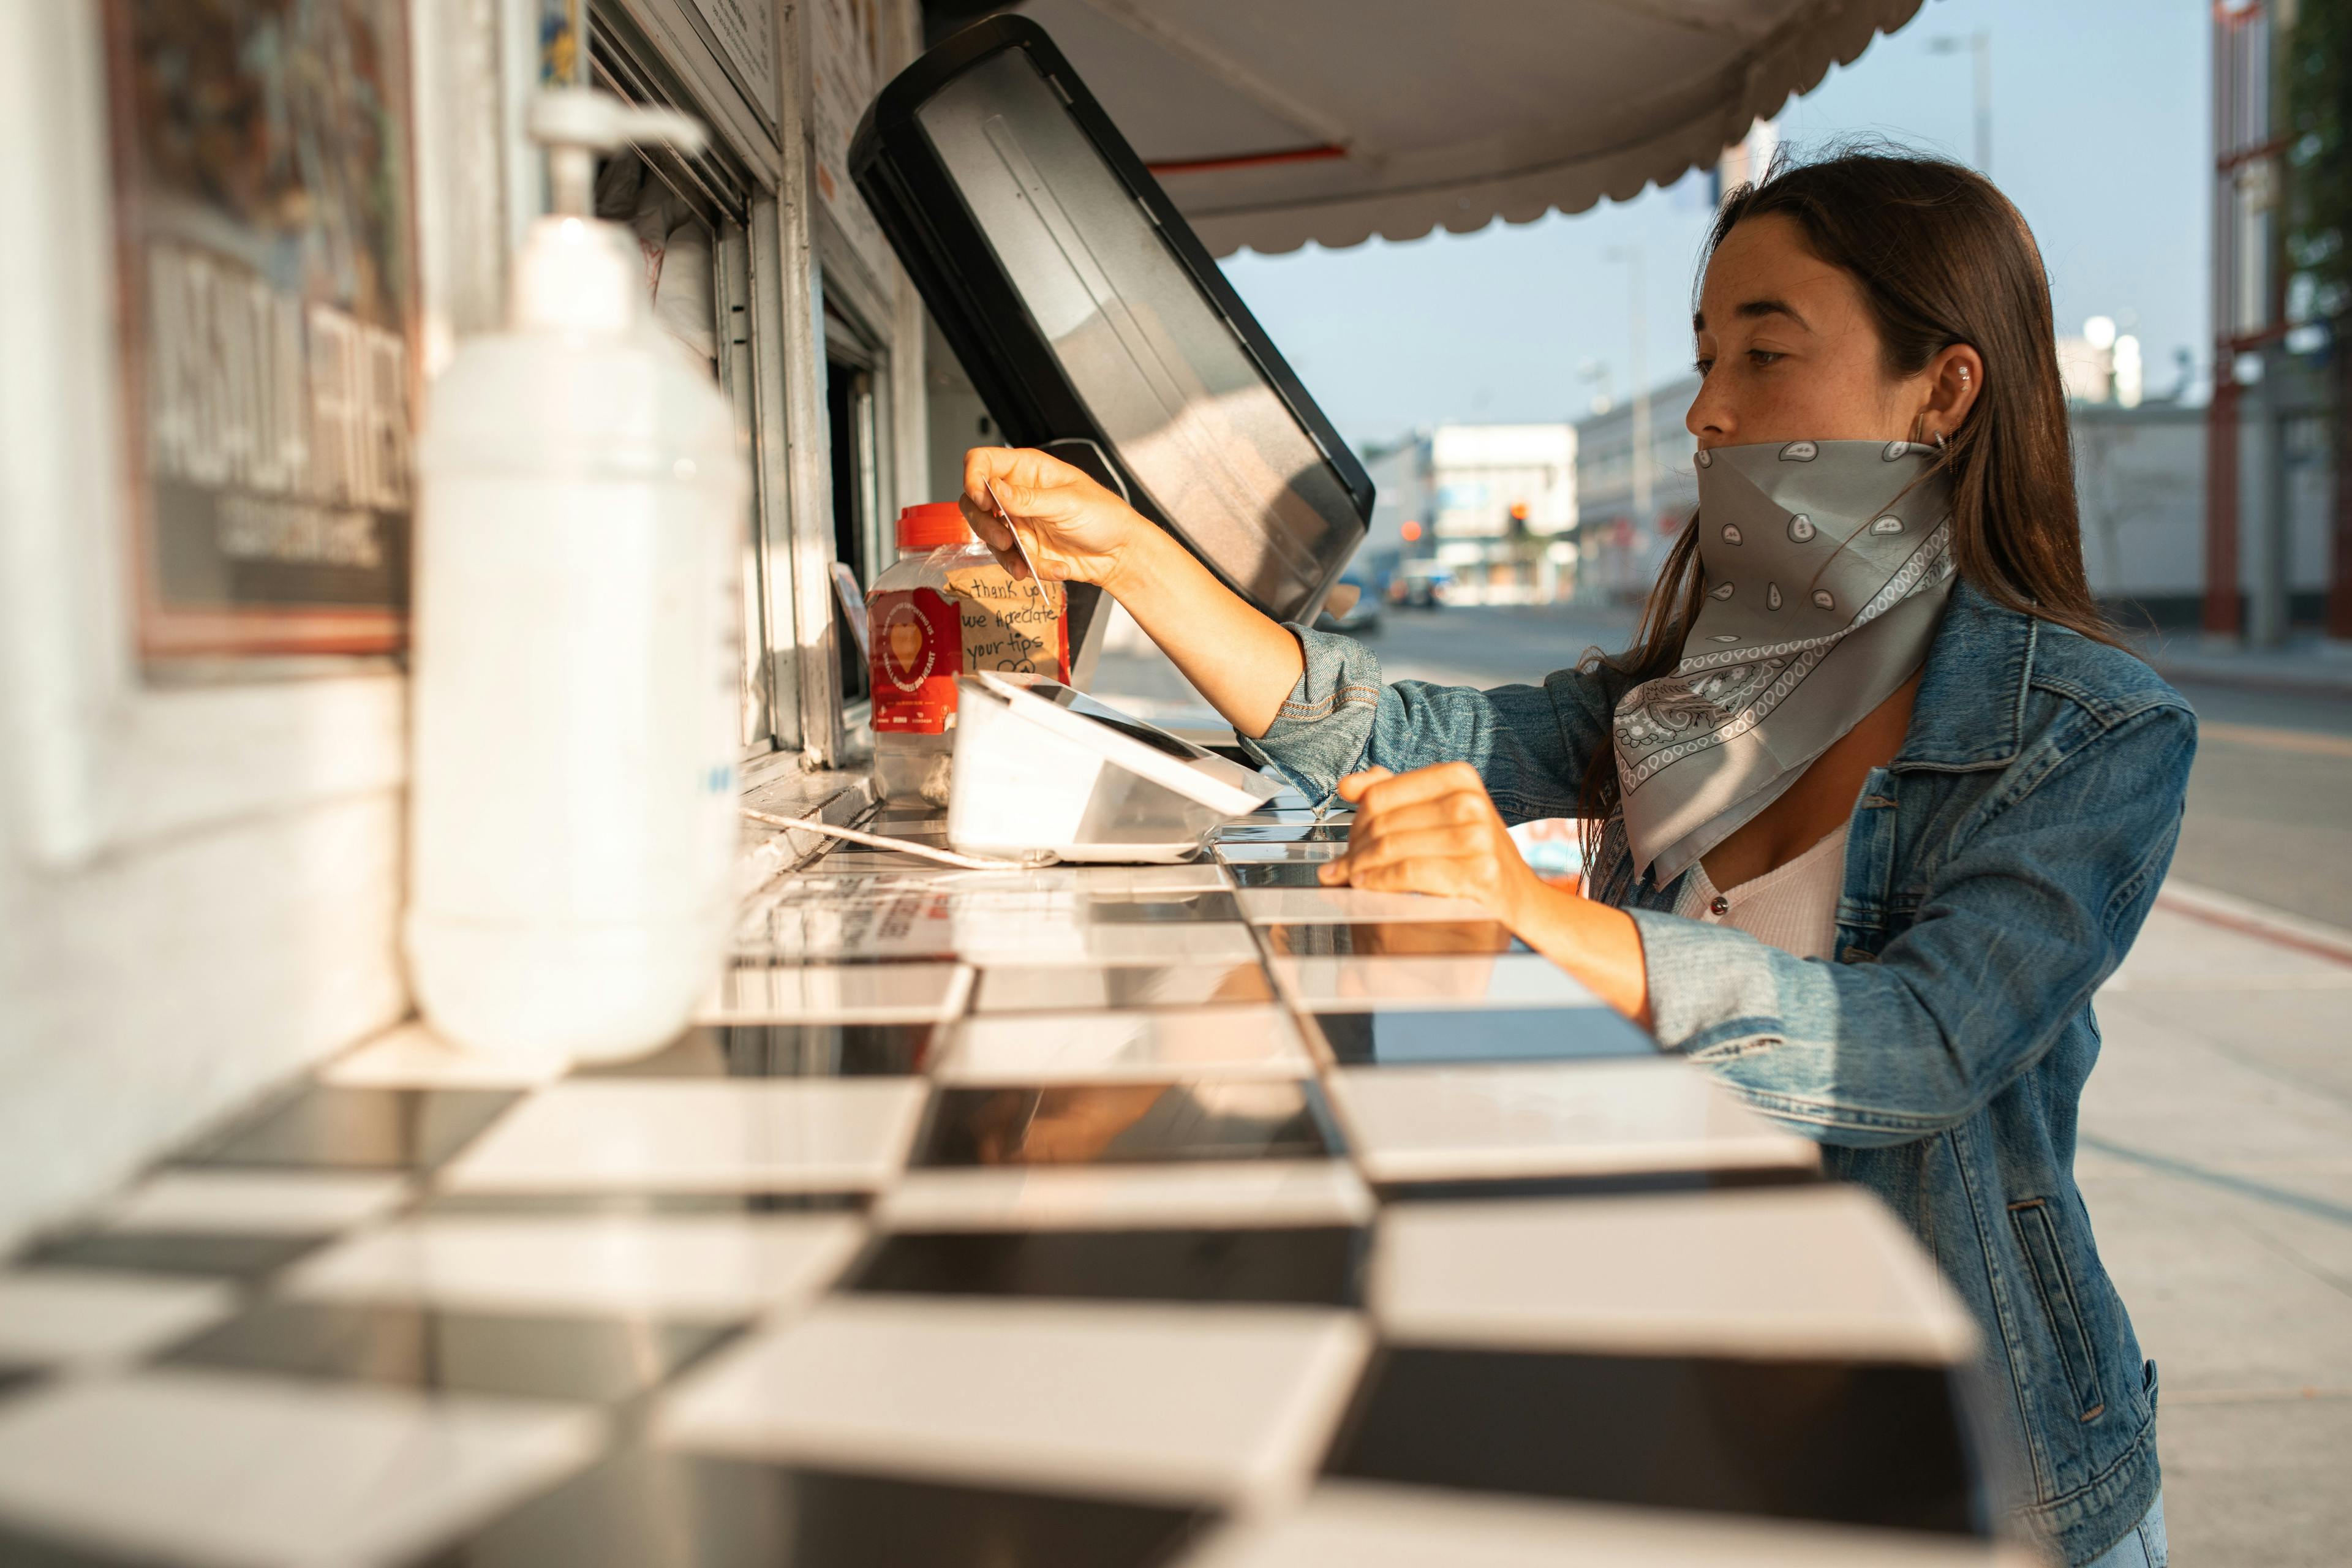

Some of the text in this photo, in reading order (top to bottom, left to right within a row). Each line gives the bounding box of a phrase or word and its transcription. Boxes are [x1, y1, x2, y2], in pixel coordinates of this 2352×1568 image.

[971, 579, 1017, 599] thank
[927, 625, 935, 636] US
[962, 614, 987, 628] we
[967, 633, 1044, 671] your tips
[922, 650, 937, 679] HEART
